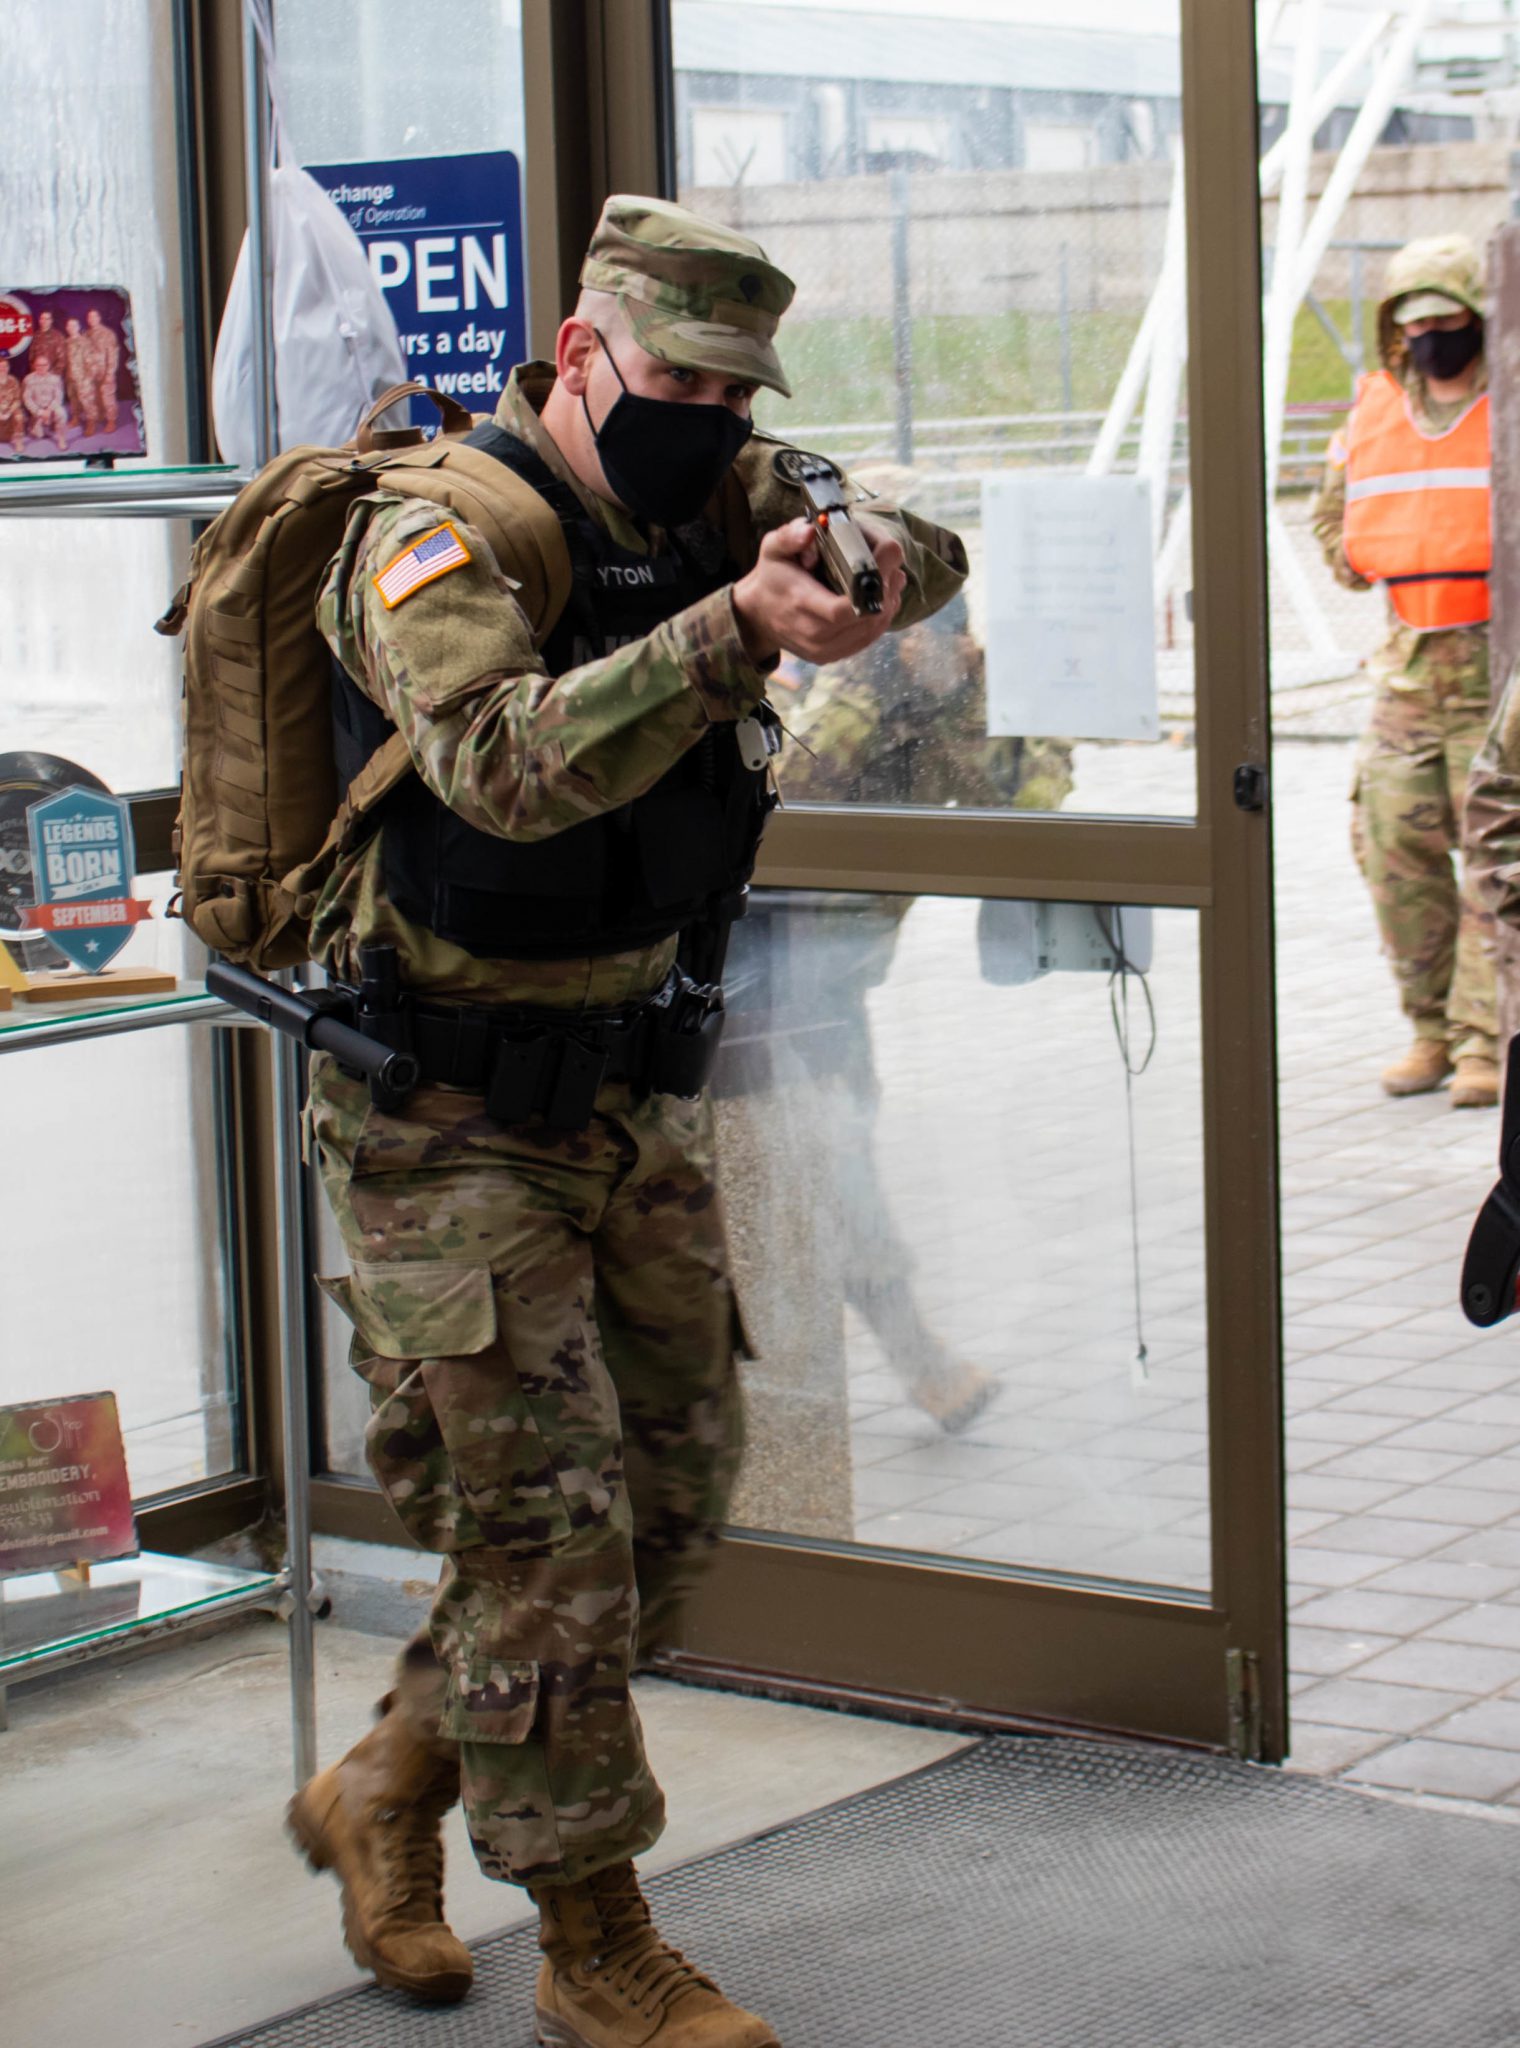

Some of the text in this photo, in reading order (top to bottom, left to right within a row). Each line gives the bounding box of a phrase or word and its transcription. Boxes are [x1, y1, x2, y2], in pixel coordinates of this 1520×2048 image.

[325, 184, 395, 205] change
[348, 205, 426, 228] of Operation
[368, 233, 508, 313] PEN
[435, 332, 452, 354] a
[458, 322, 506, 360] day
[434, 363, 503, 394] week
[597, 564, 654, 586] YTON
[43, 822, 119, 844] LEGENDS
[47, 849, 120, 885] BORN
[52, 903, 128, 927] SEPTEMBER
